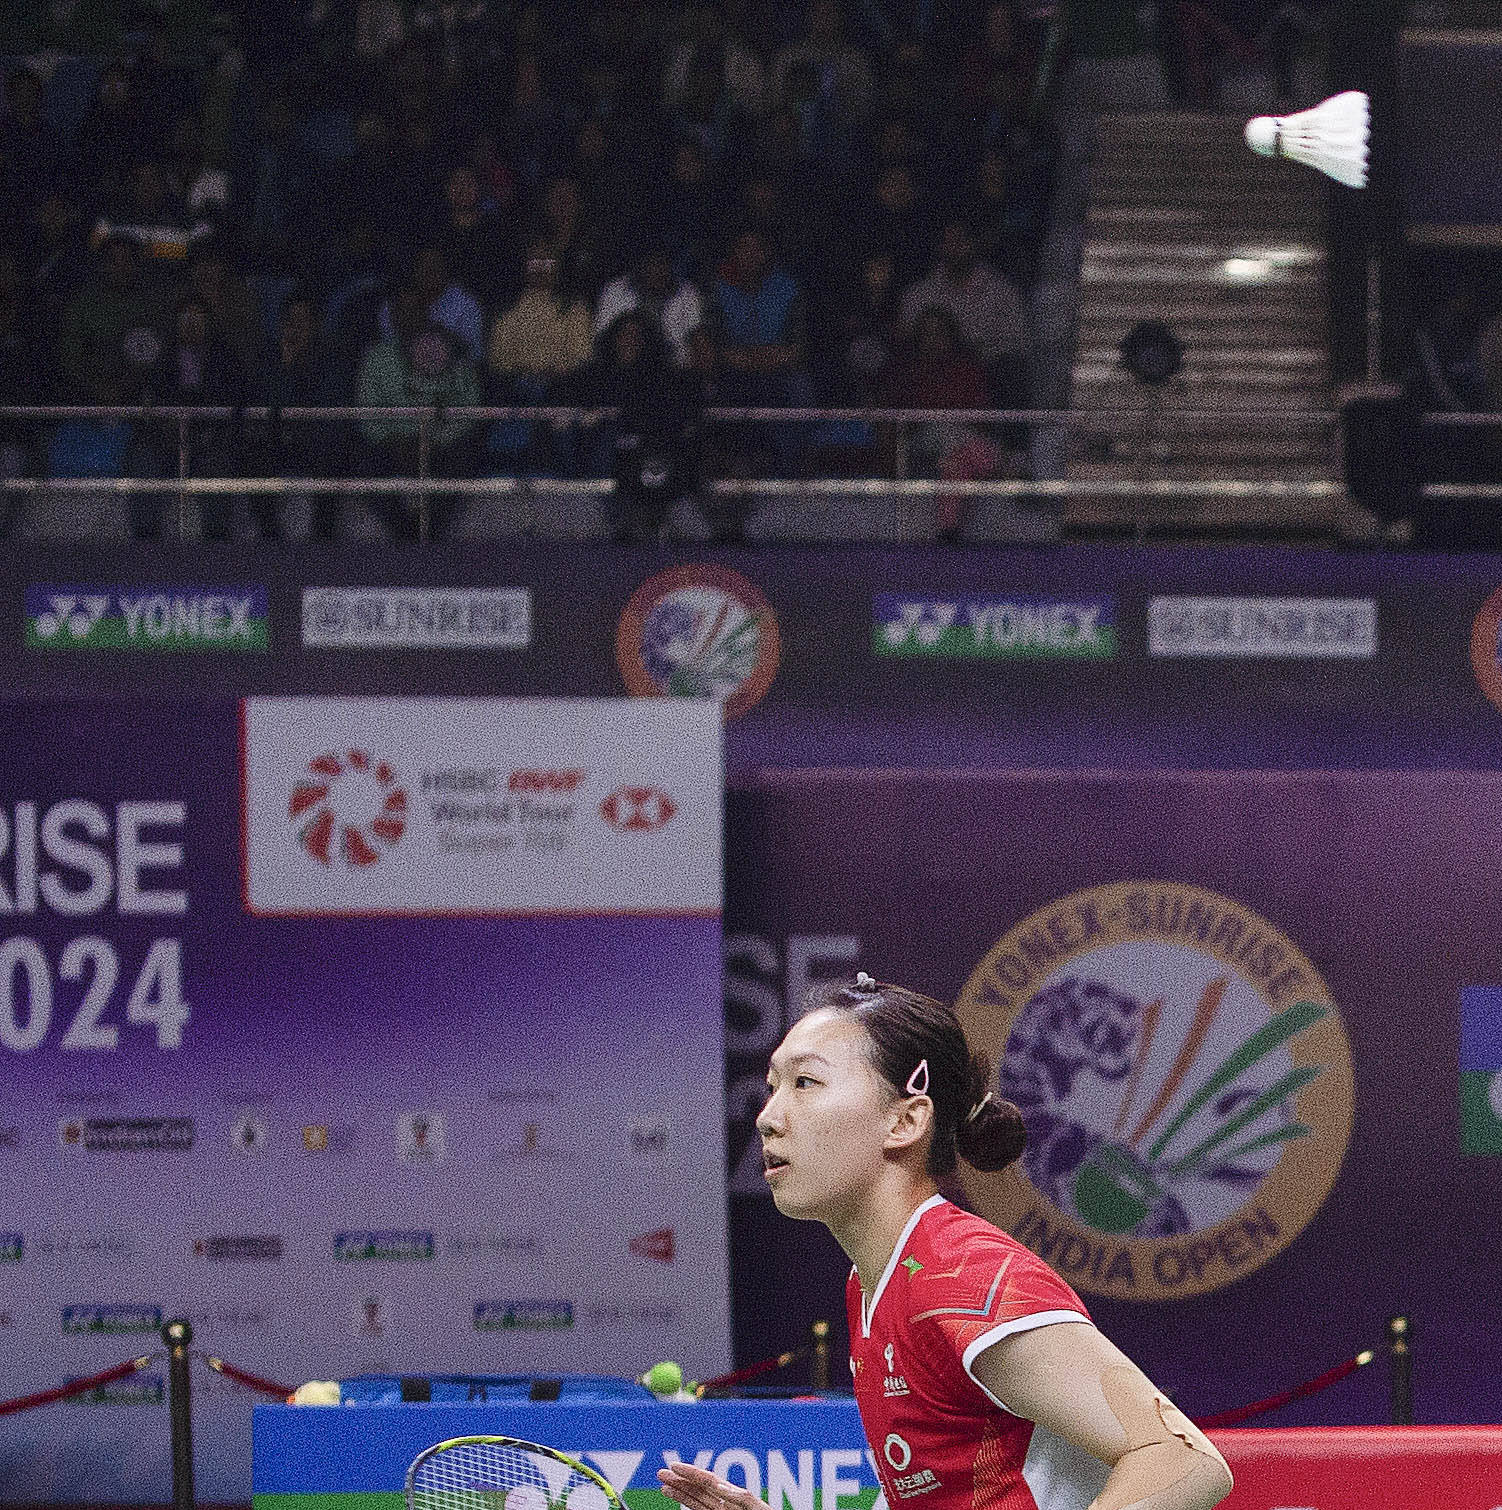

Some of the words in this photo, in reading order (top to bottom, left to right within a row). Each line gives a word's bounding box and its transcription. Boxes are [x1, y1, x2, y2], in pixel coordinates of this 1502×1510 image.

[121, 594, 254, 640] YONEX
[969, 604, 1100, 647] YONEX
[0, 800, 188, 914] ISE
[1013, 1207, 1136, 1288] INDIA
[1152, 1207, 1281, 1288] OPEN
